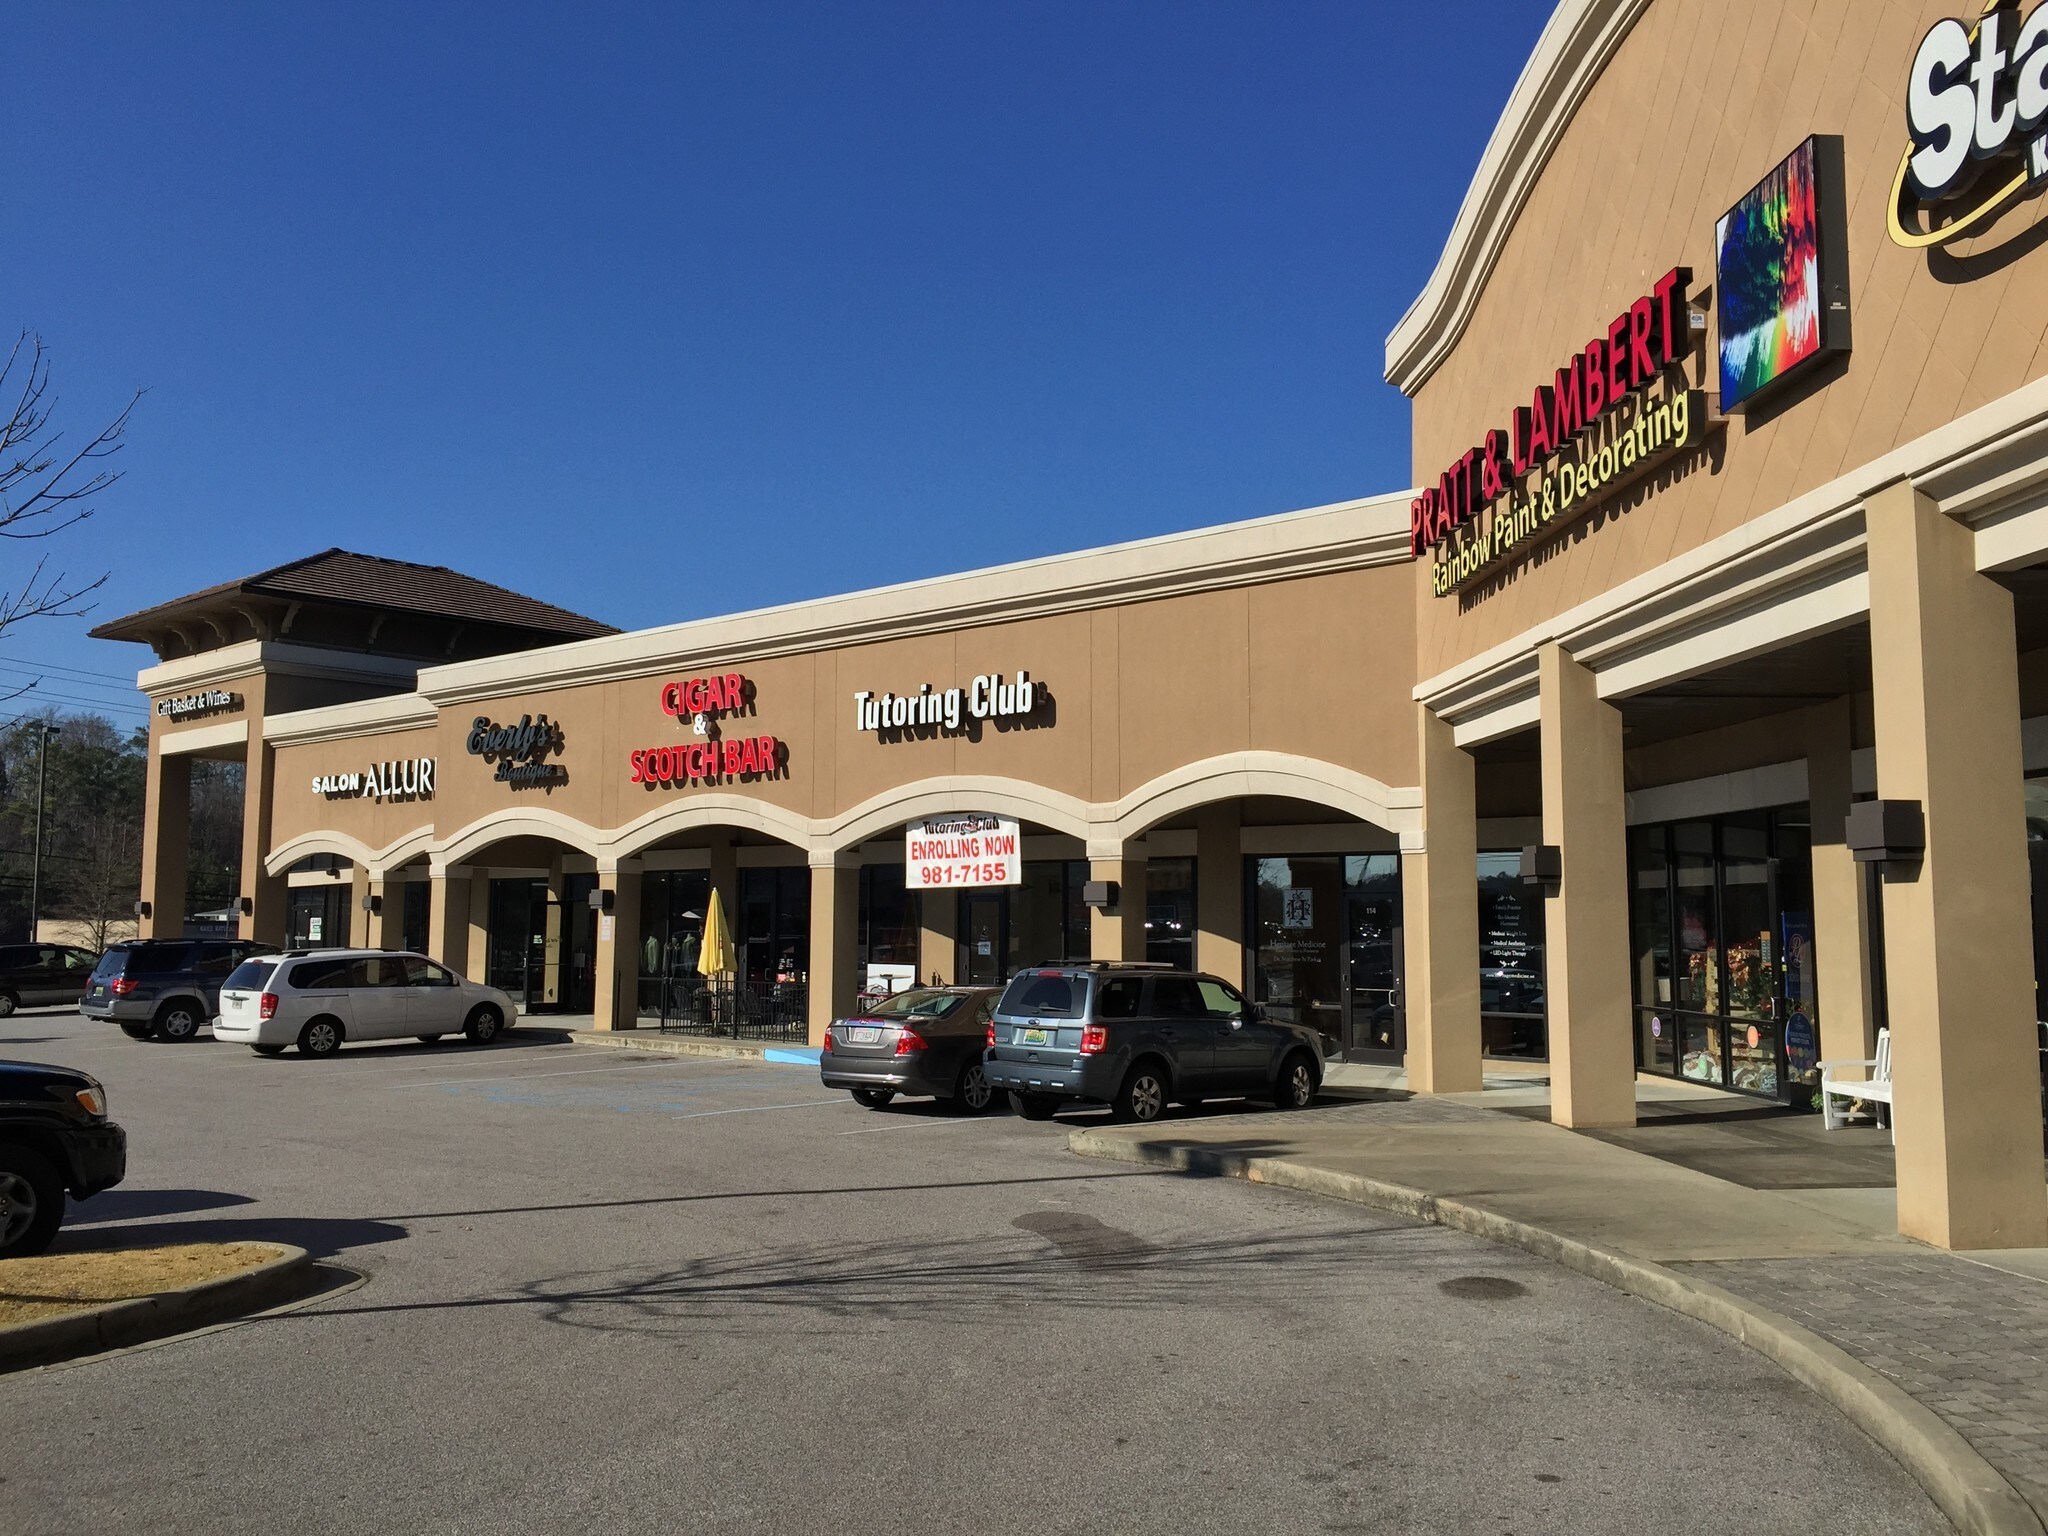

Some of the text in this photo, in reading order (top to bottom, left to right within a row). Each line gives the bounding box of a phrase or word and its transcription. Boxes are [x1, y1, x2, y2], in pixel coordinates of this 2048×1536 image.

[1411, 267, 1680, 557] PRATT & LAMBERT
[1432, 388, 1691, 598] Rainbow Paint & Decorating
[156, 689, 231, 716] Gift Basket & Wines
[660, 672, 743, 717] CIGAR
[854, 670, 1034, 731] Tutoring Club
[467, 714, 548, 762] Everly's
[693, 713, 707, 735] &
[494, 759, 553, 786] Boutique
[630, 735, 776, 783] SCOTCH BAR
[311, 756, 438, 798] SALON ALLUR
[922, 815, 1000, 836] Tutoring Club
[911, 834, 1015, 861] ENROLLING NOW
[921, 862, 1007, 885] 981-7155
[1297, 940, 1326, 949] Medicine
